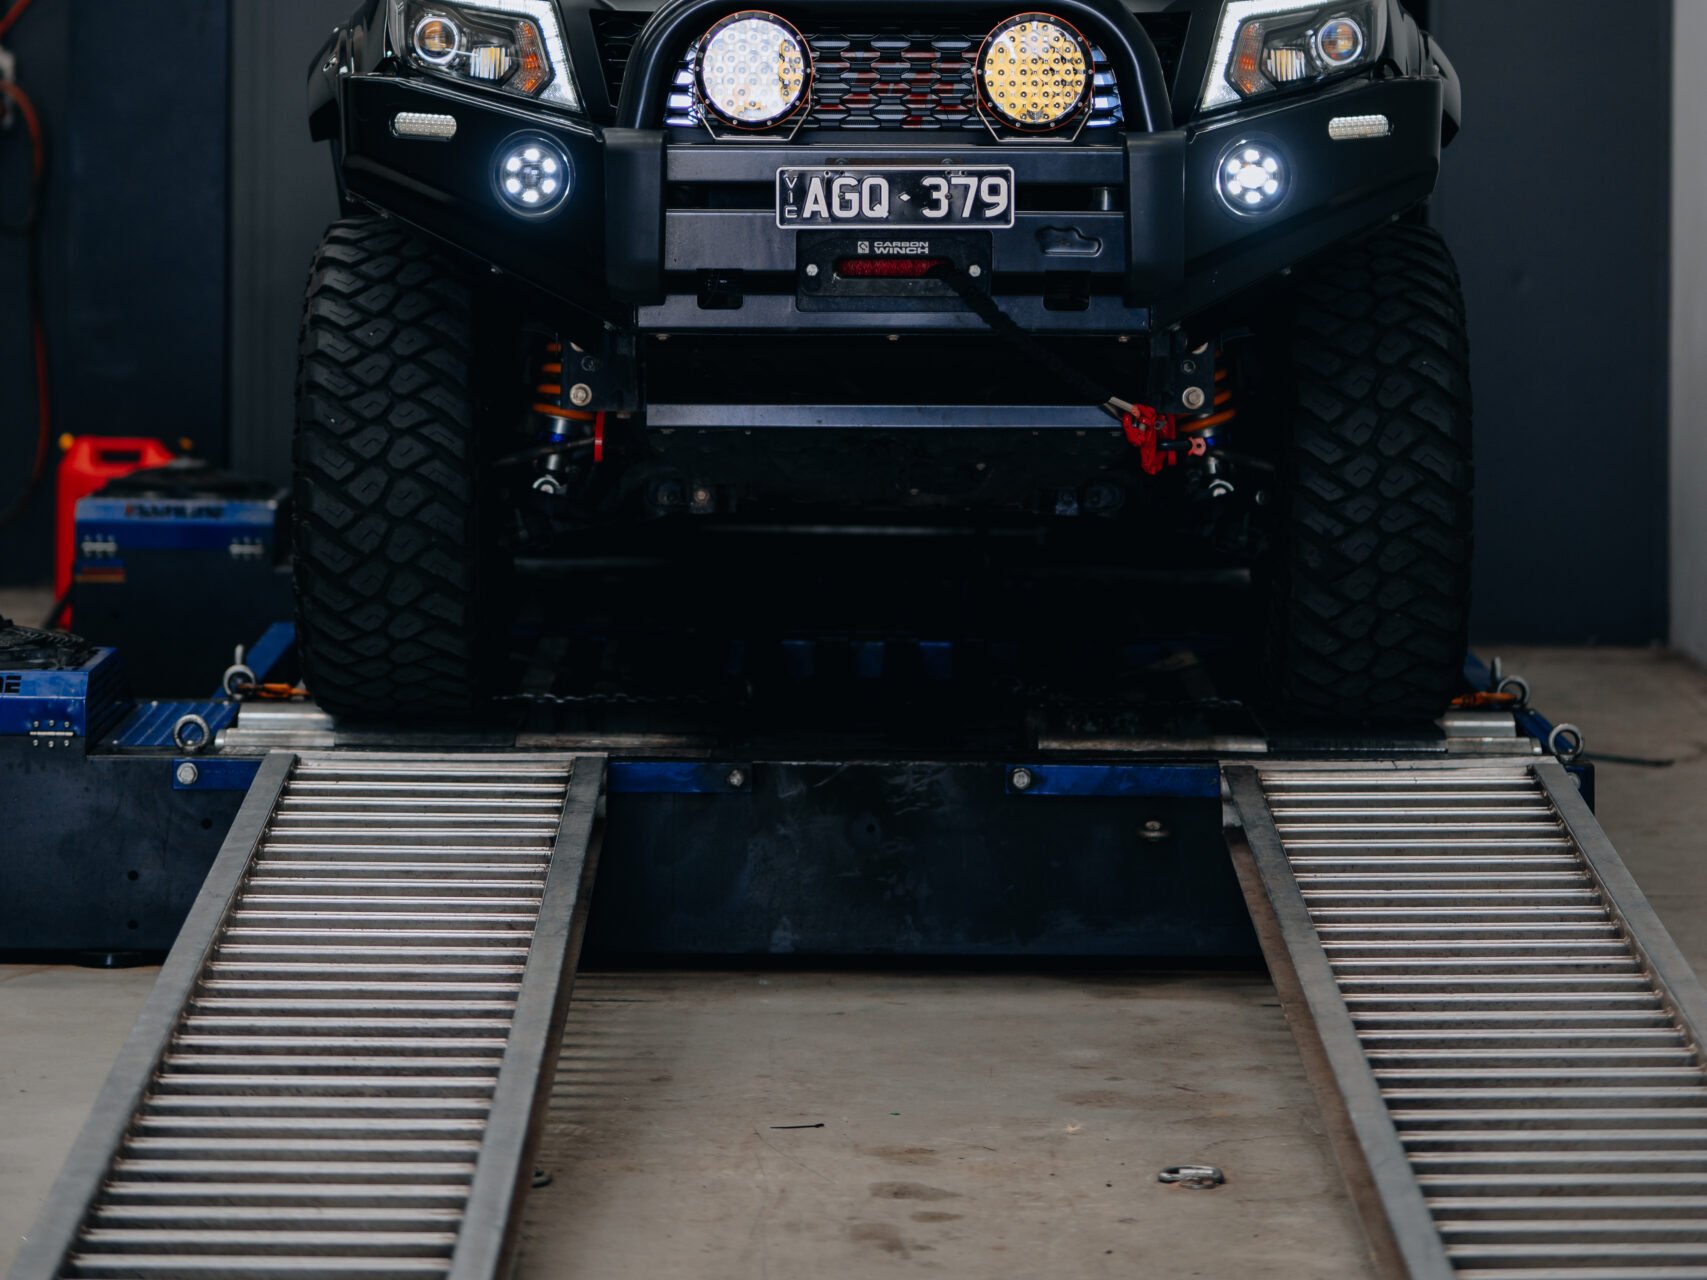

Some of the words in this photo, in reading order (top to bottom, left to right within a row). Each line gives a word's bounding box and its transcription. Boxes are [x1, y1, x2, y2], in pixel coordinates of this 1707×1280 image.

[784, 176, 798, 219] VIC
[802, 176, 891, 219] AGQ
[920, 176, 1009, 219] 379
